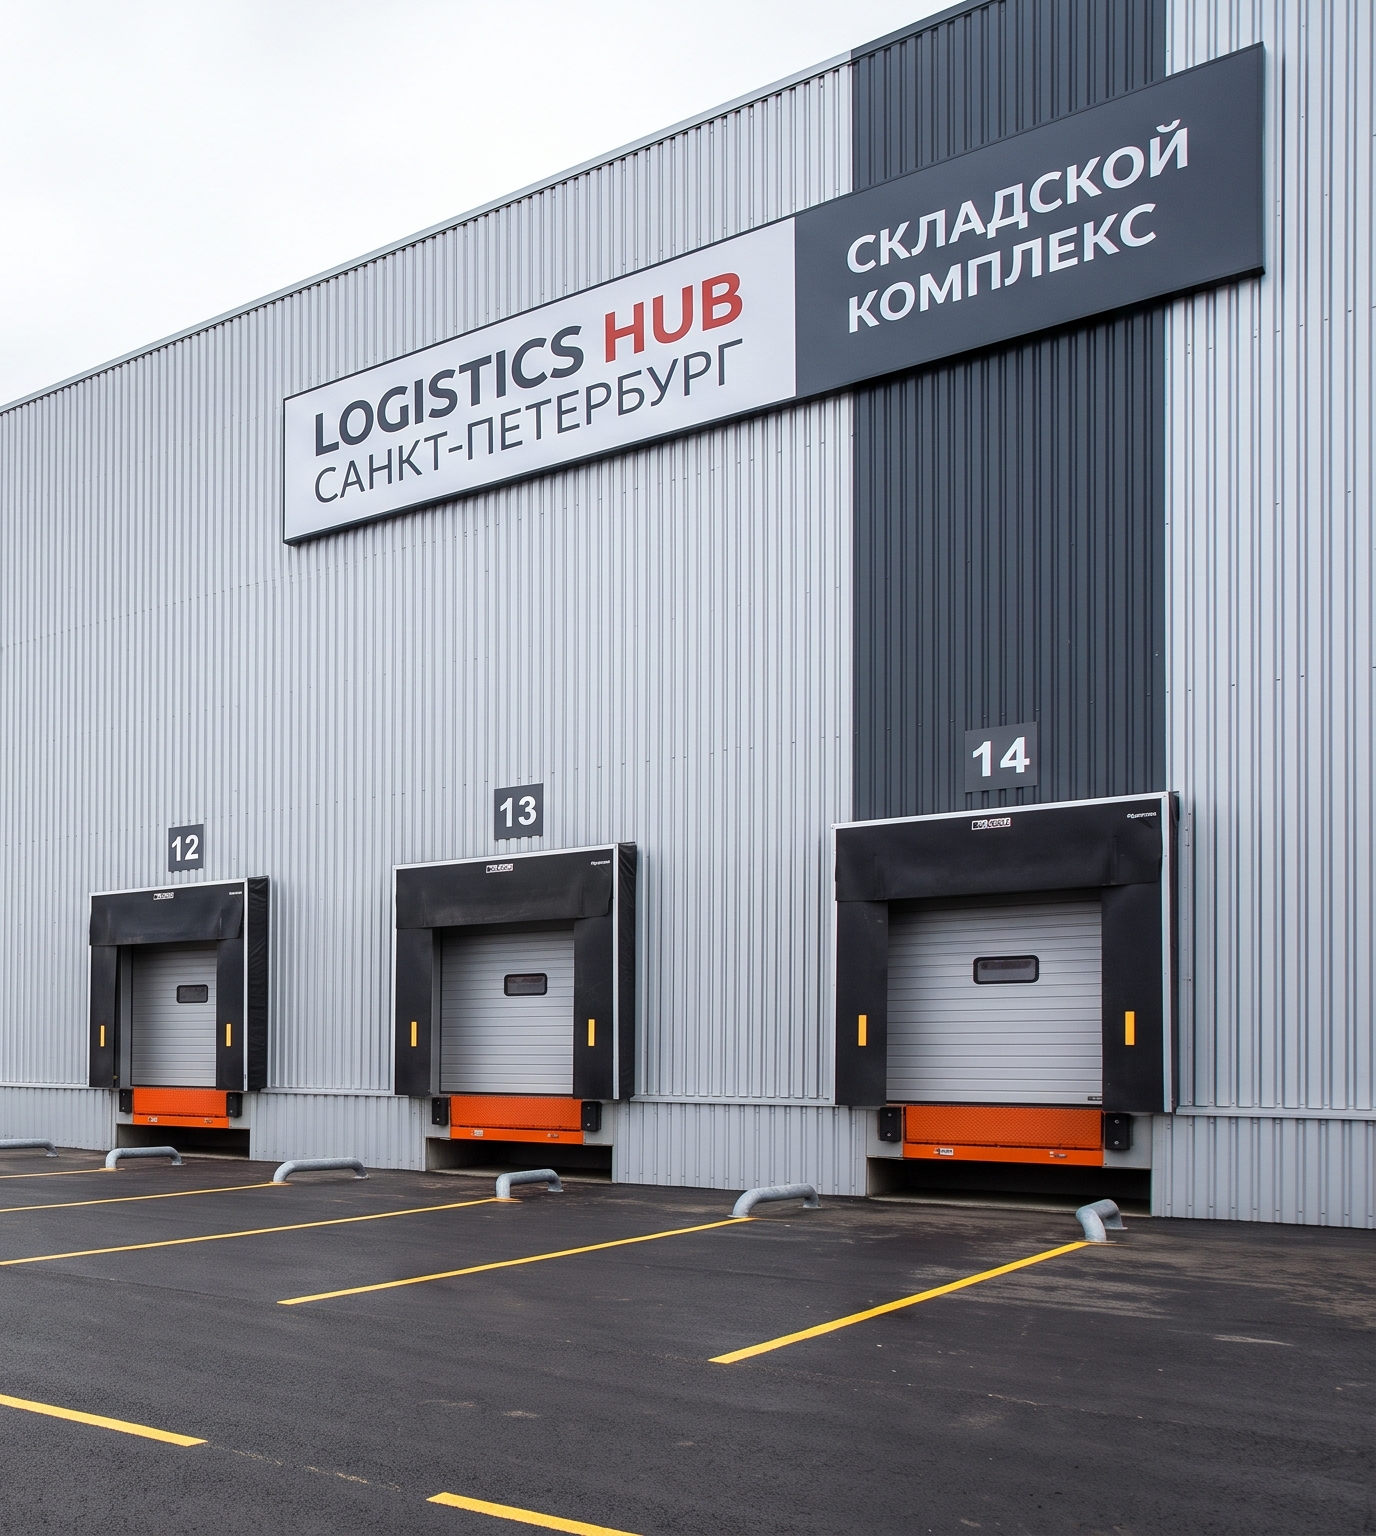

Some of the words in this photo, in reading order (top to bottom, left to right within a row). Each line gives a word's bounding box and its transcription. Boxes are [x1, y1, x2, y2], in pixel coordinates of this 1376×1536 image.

[846, 118, 1188, 274] СКЛАДСКОЙ
[848, 203, 1157, 334] КОМПЛЕКС
[314, 325, 584, 457] LOGISTICS
[604, 272, 744, 364] HUB
[314, 337, 744, 504] САНКТ-ПЕТЕРБУРГ
[499, 795, 537, 828] 13
[972, 736, 1030, 777] 14
[171, 834, 199, 862] 12
